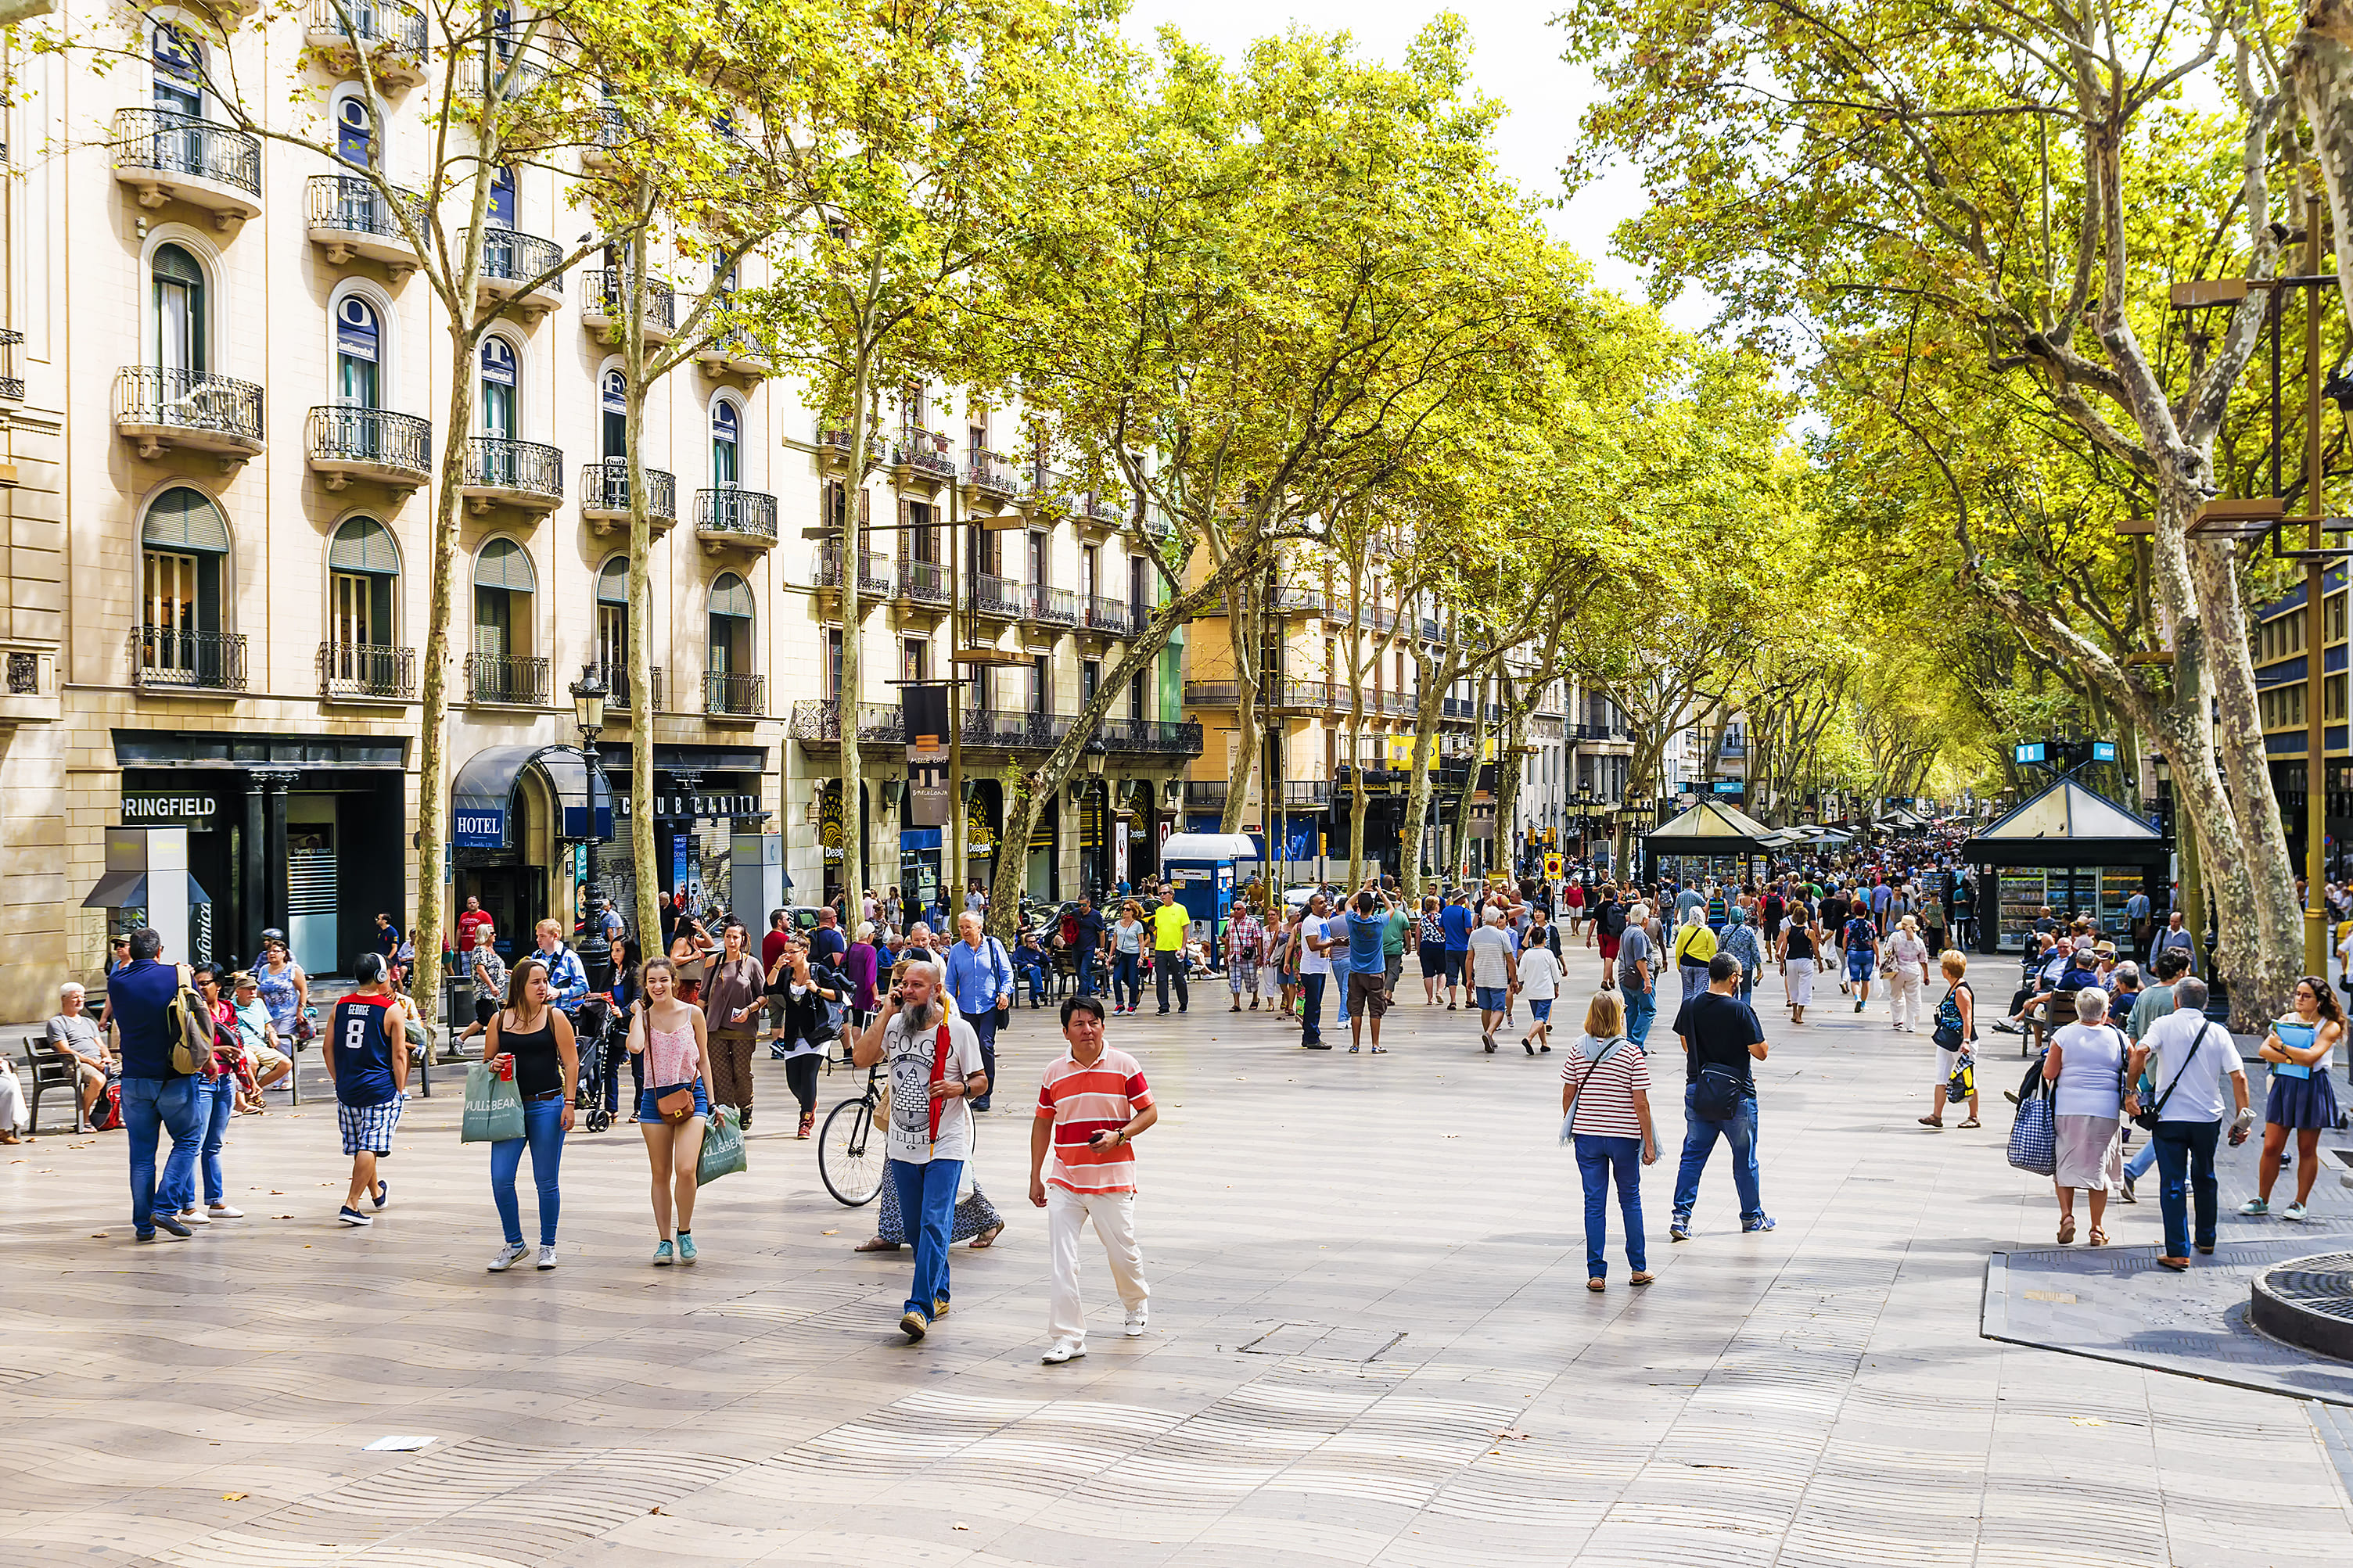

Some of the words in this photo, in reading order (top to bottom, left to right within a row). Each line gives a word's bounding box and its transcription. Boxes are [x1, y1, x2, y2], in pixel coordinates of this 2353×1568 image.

[338, 299, 372, 327] O
[337, 339, 375, 358] ontinental
[482, 338, 510, 364] T
[713, 402, 734, 426] L
[932, 755, 948, 764] 2015
[622, 796, 680, 815] CUB
[457, 817, 500, 834] HOTEL
[567, 862, 573, 870] H
[347, 1003, 371, 1016] GEORGE
[346, 1018, 365, 1049] 8
